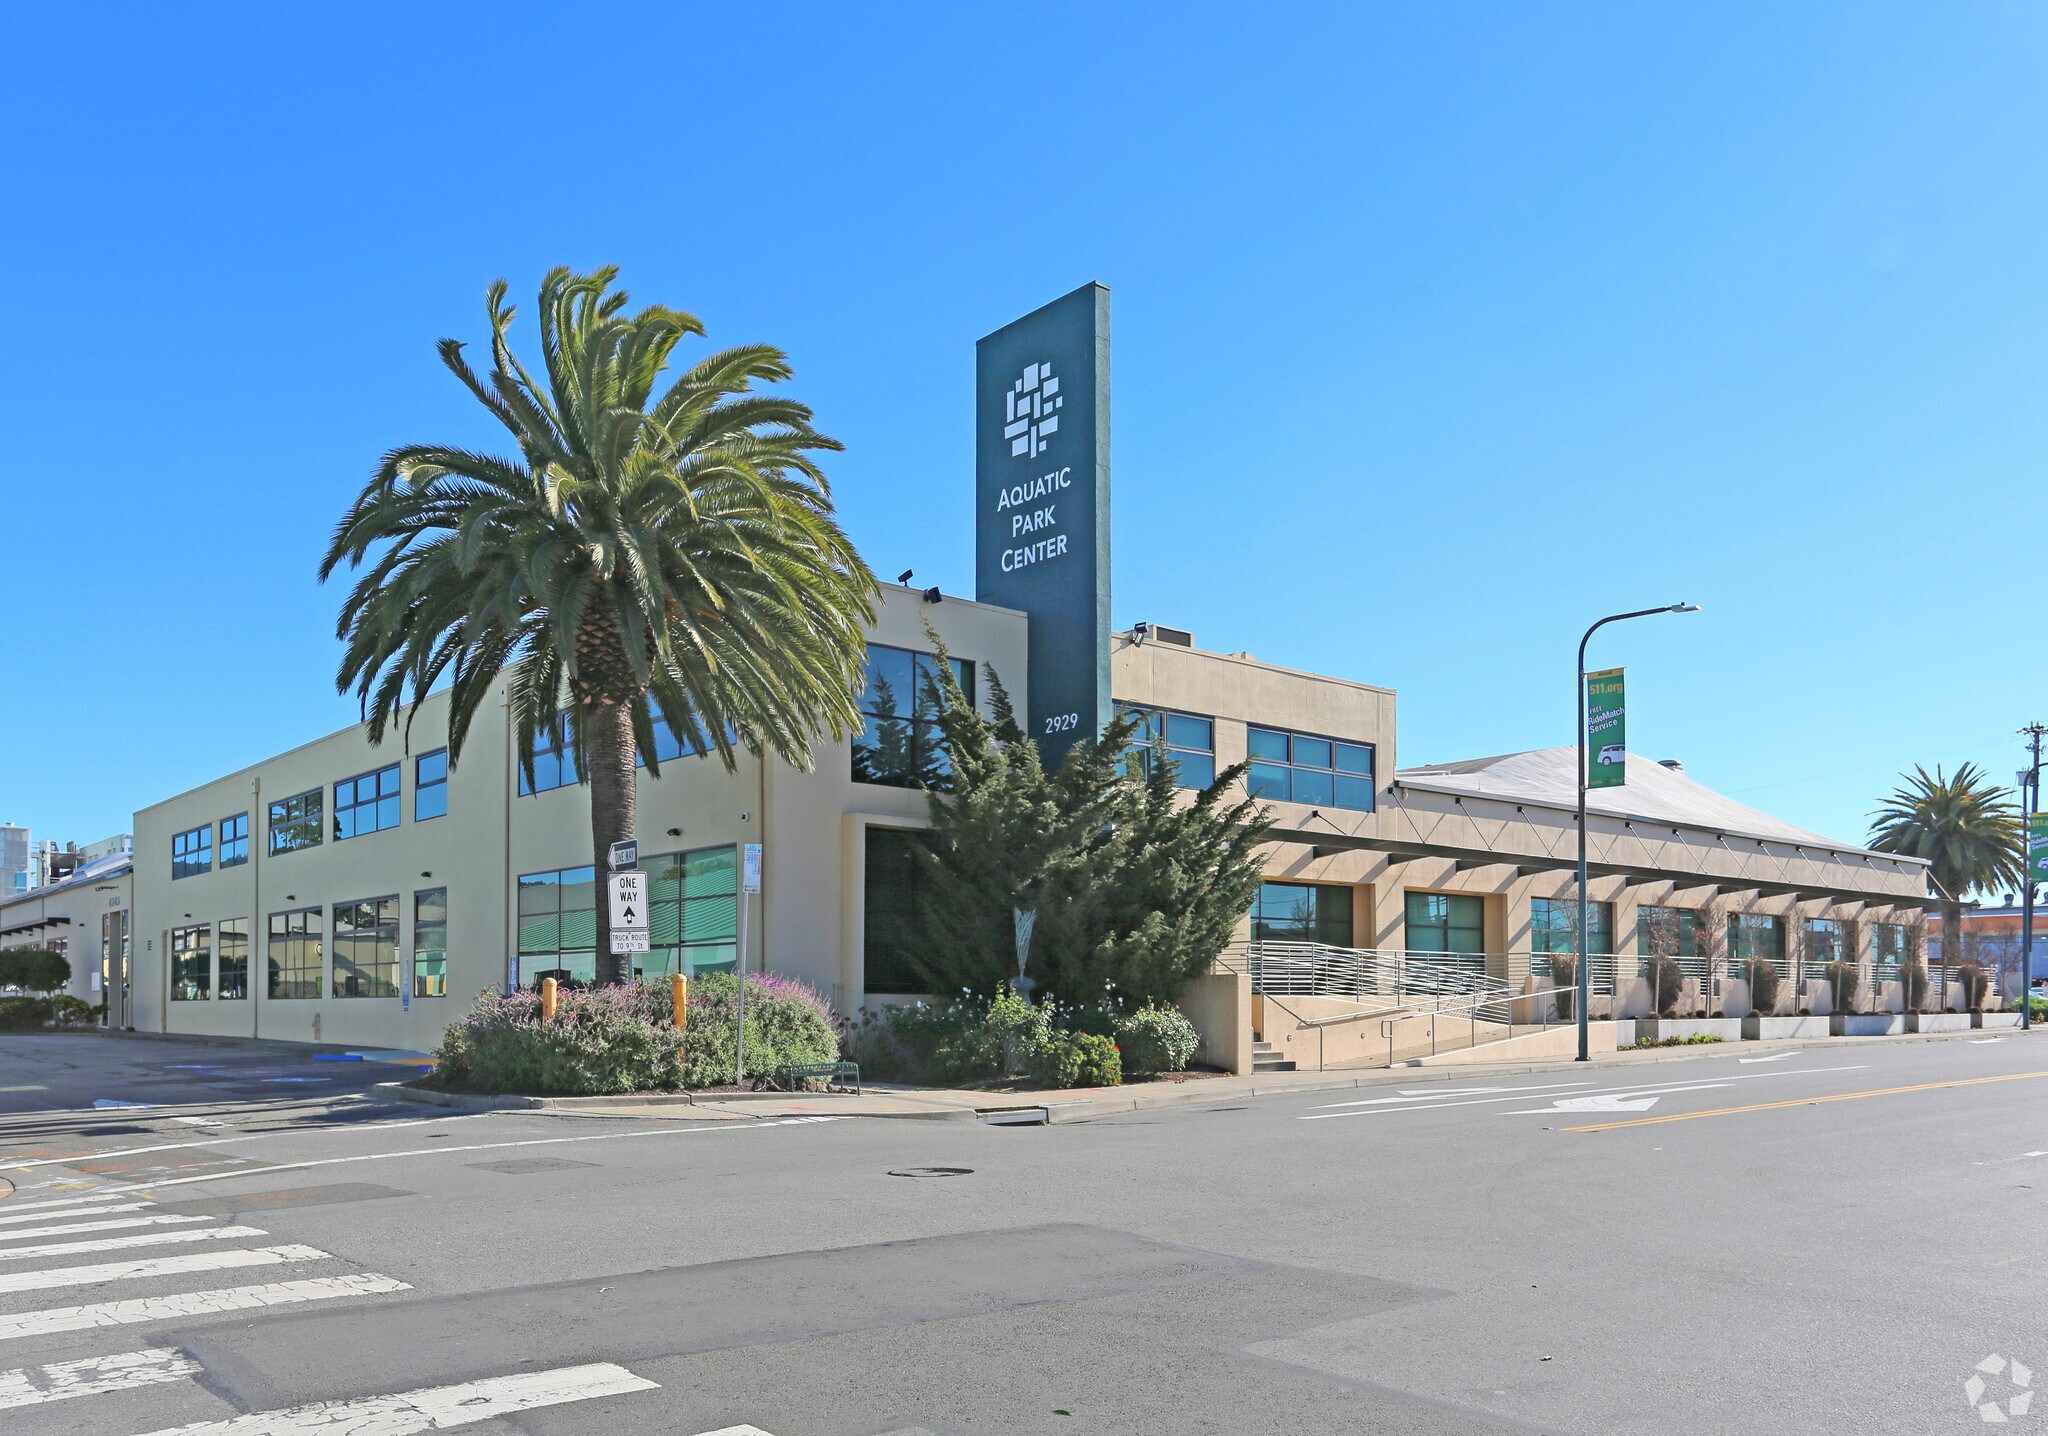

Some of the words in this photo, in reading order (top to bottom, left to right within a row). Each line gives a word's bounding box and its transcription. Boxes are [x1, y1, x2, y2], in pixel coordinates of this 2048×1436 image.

[997, 466, 1071, 512] AQUATIC
[1012, 504, 1056, 538] PARK
[1001, 534, 1067, 572] CENTER
[1590, 683, 1623, 695] 511.org
[1588, 706, 1625, 725] RideMatch
[1045, 713, 1078, 734] 2929
[1590, 719, 1618, 734] Service
[615, 851, 624, 863] ONE
[625, 848, 635, 861] WAY
[619, 877, 637, 889] ONE
[619, 891, 638, 902] WAY
[612, 934, 629, 942] TRUCK
